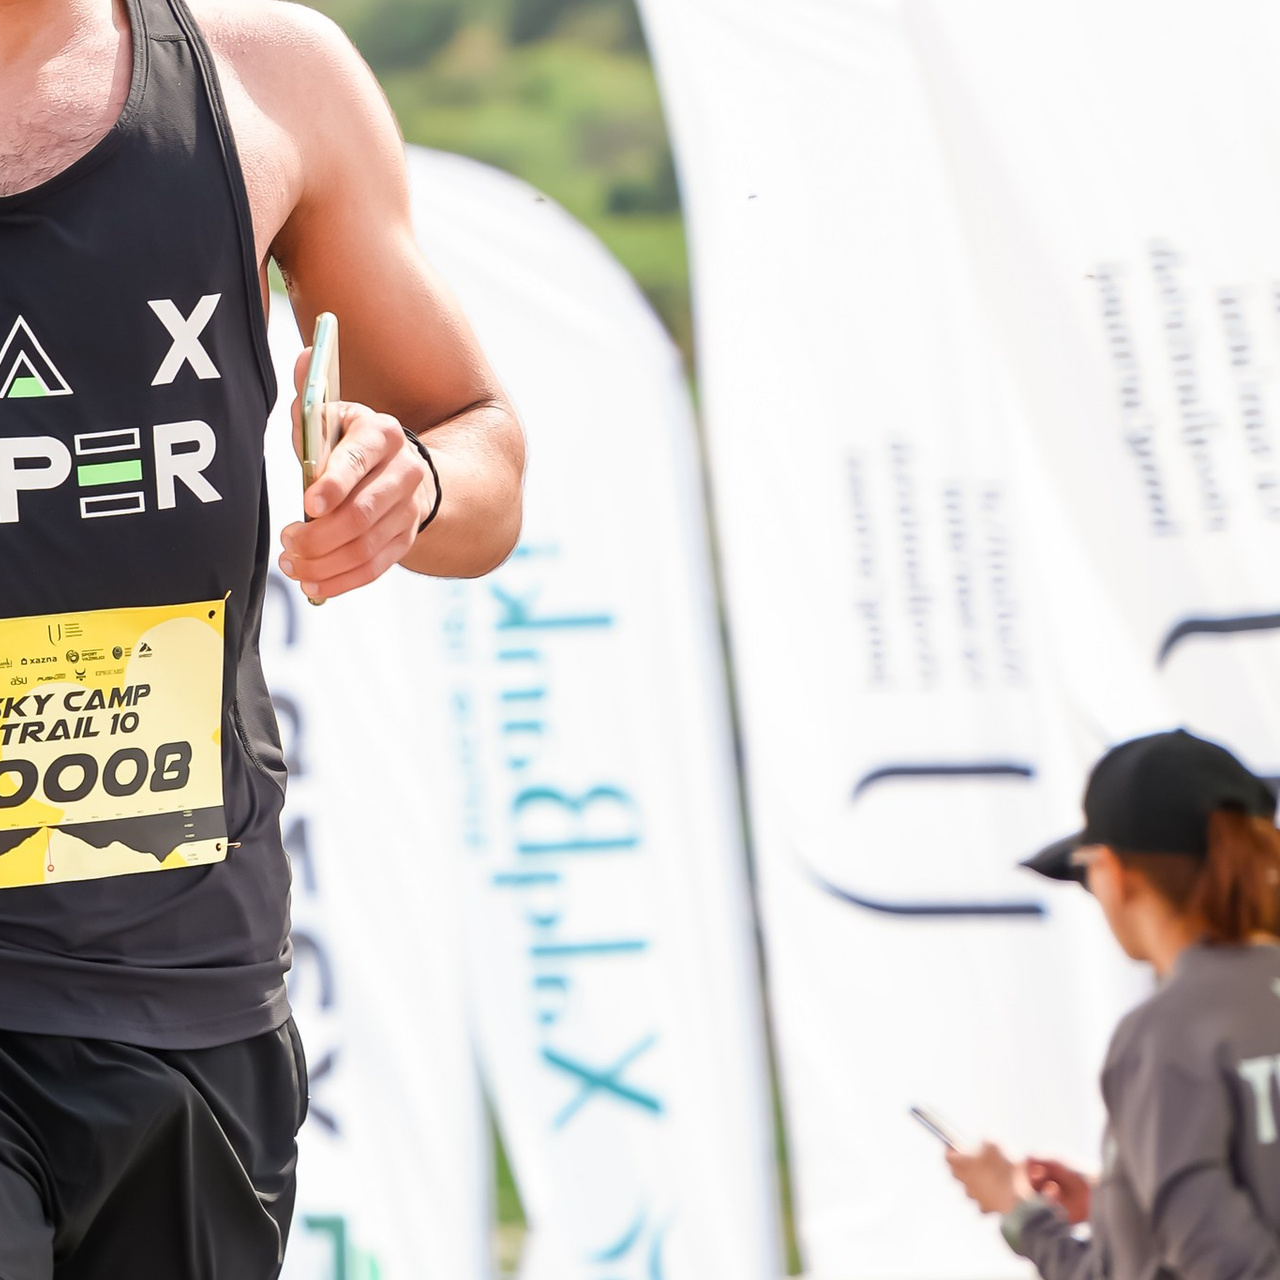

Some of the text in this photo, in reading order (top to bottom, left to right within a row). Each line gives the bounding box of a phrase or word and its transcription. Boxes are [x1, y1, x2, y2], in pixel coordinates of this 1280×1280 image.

[29, 656, 58, 665] xazna
[63, 683, 152, 712] CAMP
[0, 711, 140, 746] TRAIL 10
